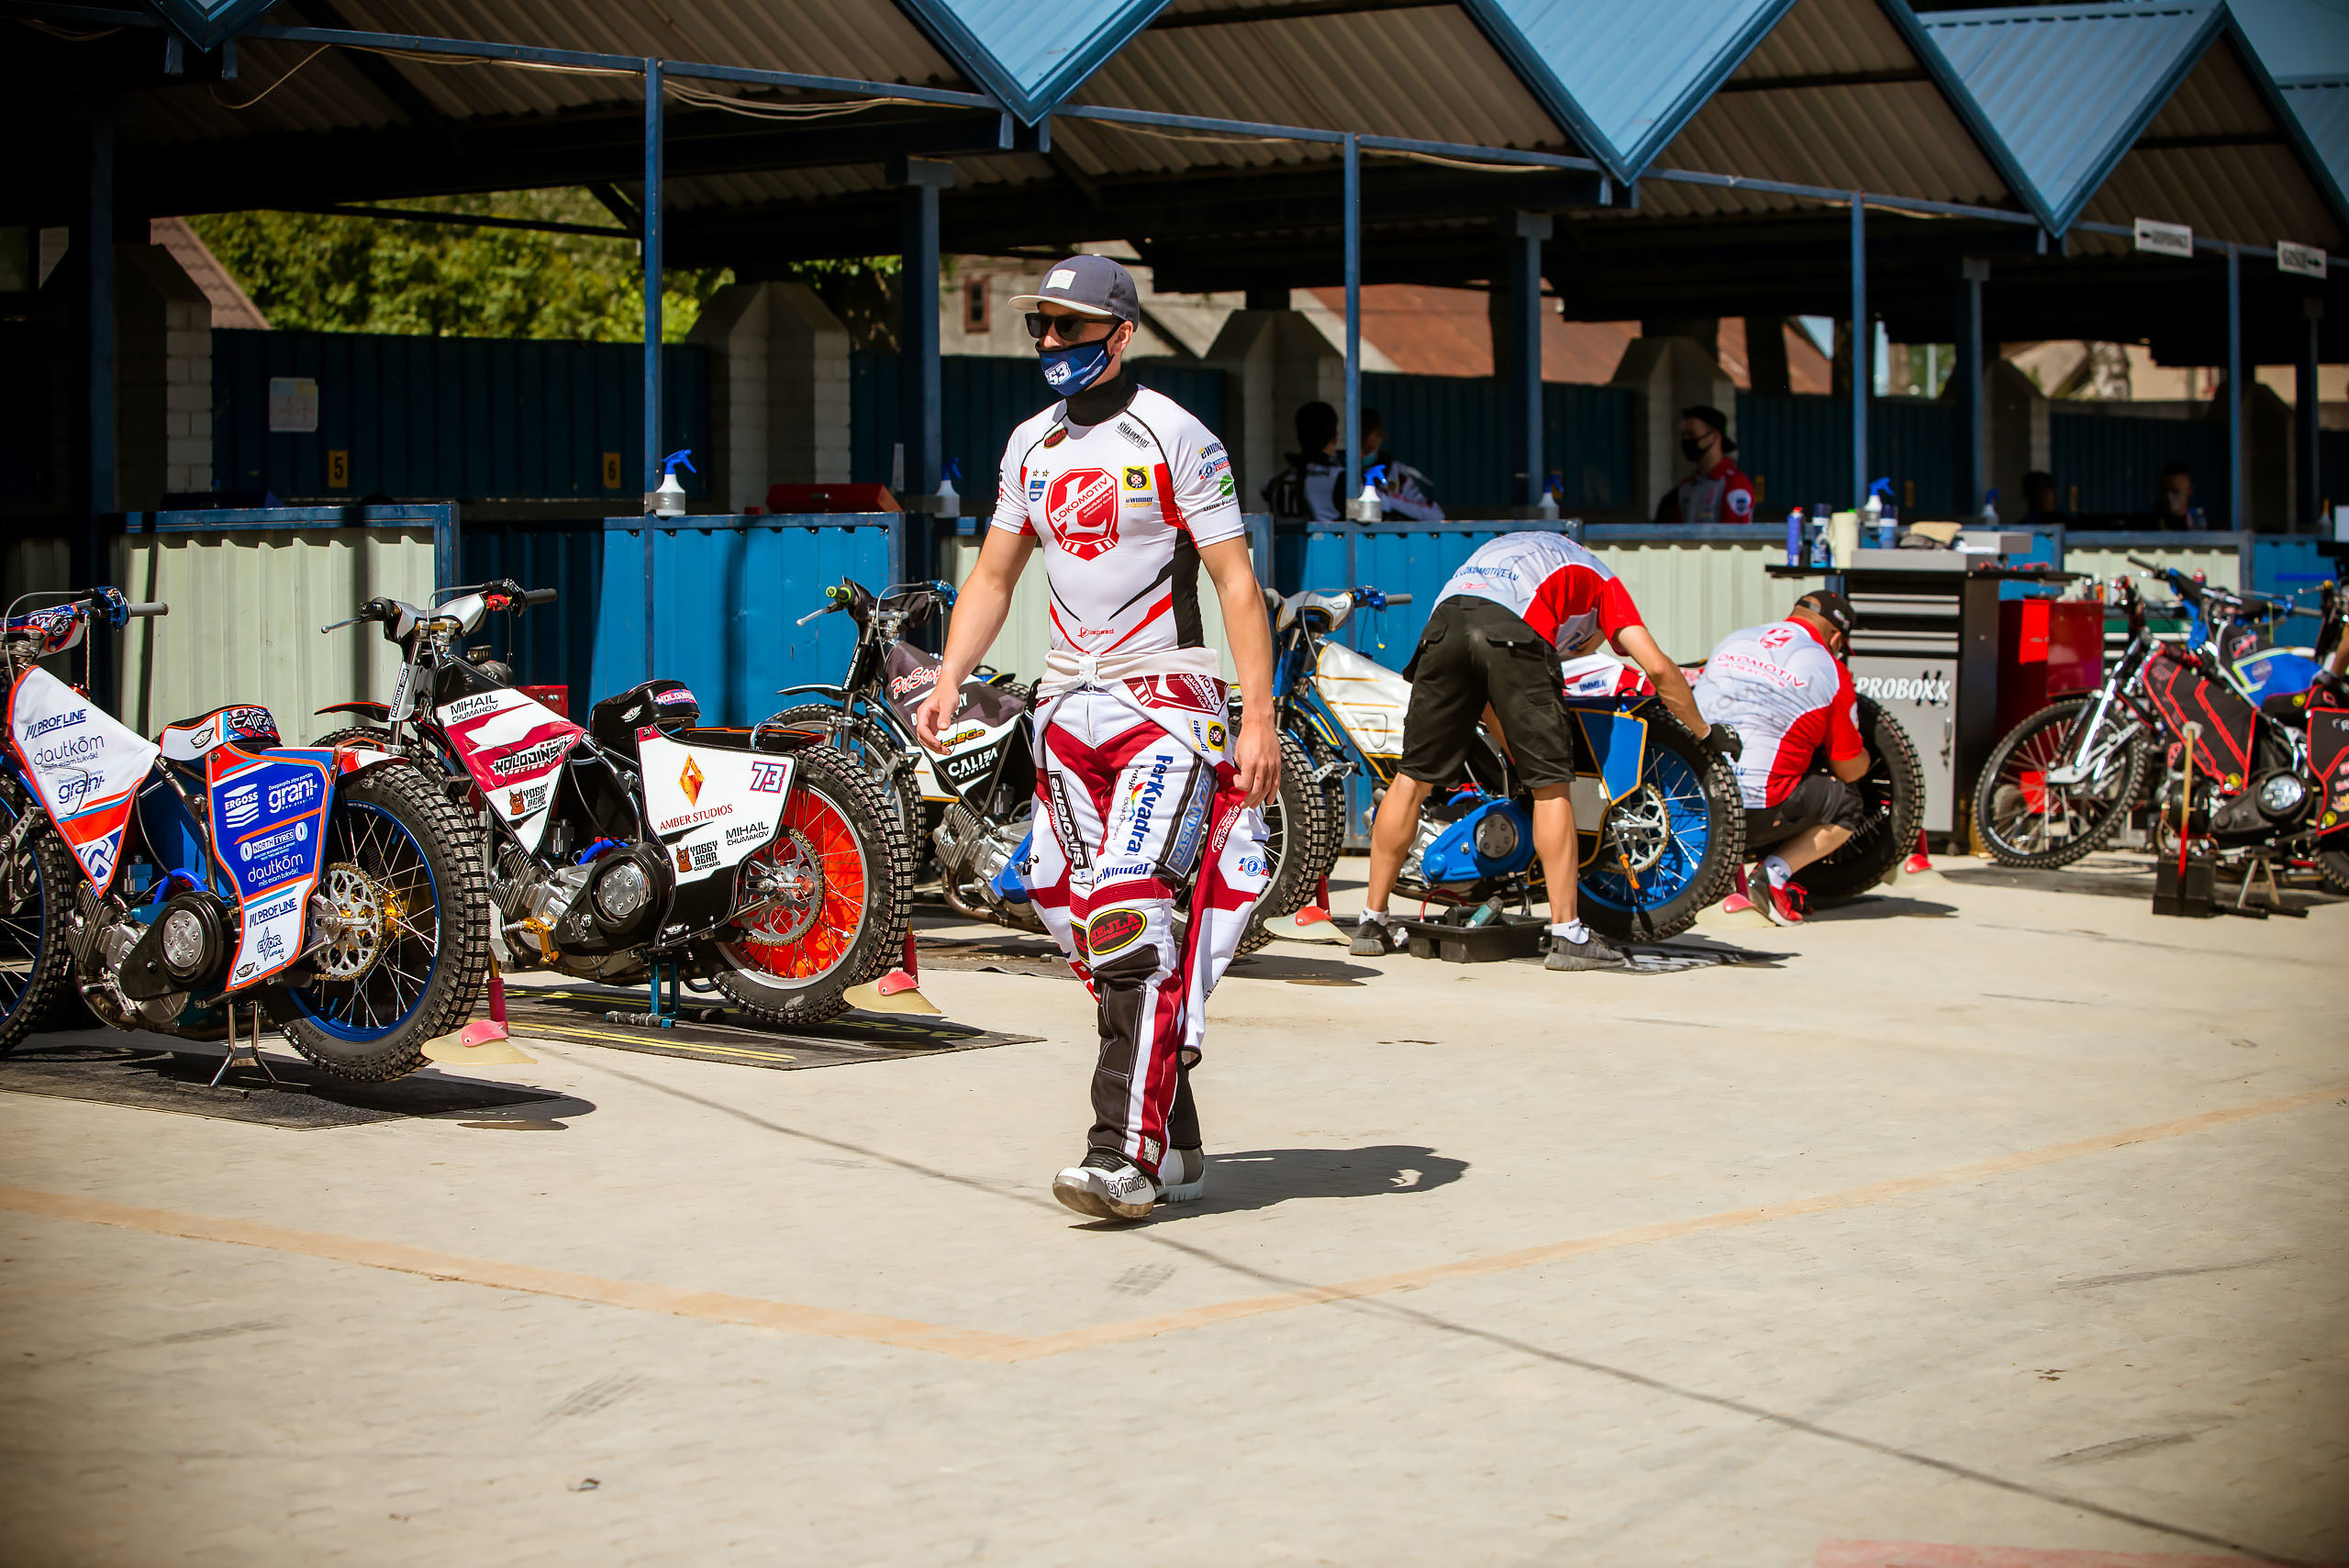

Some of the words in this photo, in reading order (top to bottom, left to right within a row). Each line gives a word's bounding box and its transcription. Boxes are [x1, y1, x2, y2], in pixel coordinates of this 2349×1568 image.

[1048, 367, 1069, 385] 53
[334, 457, 343, 480] 5
[1052, 476, 1108, 523] LOKOMOTIV
[1854, 674, 1952, 703] PROBOXX
[450, 695, 498, 716] MIHAIL
[451, 704, 498, 723] CHUMAKOV
[750, 761, 786, 794] 73
[224, 791, 259, 811] ERGOSS
[1125, 754, 1174, 855] PerKvadra
[660, 814, 692, 831] AMBER
[693, 804, 733, 823] STUDIOS
[1216, 805, 1241, 851] BRODDSON
[253, 839, 273, 852] NORTH
[274, 831, 295, 846] TYRES
[725, 821, 770, 840] MIHAIL
[727, 830, 770, 846] CHUMAKOV
[1174, 807, 1202, 864] MASKIN
[690, 840, 718, 857] YOGGY
[695, 851, 718, 866] BEAR
[1096, 862, 1152, 884] eWinner
[1089, 914, 1140, 944] HEJLA
[1104, 1174, 1147, 1198] aytona
